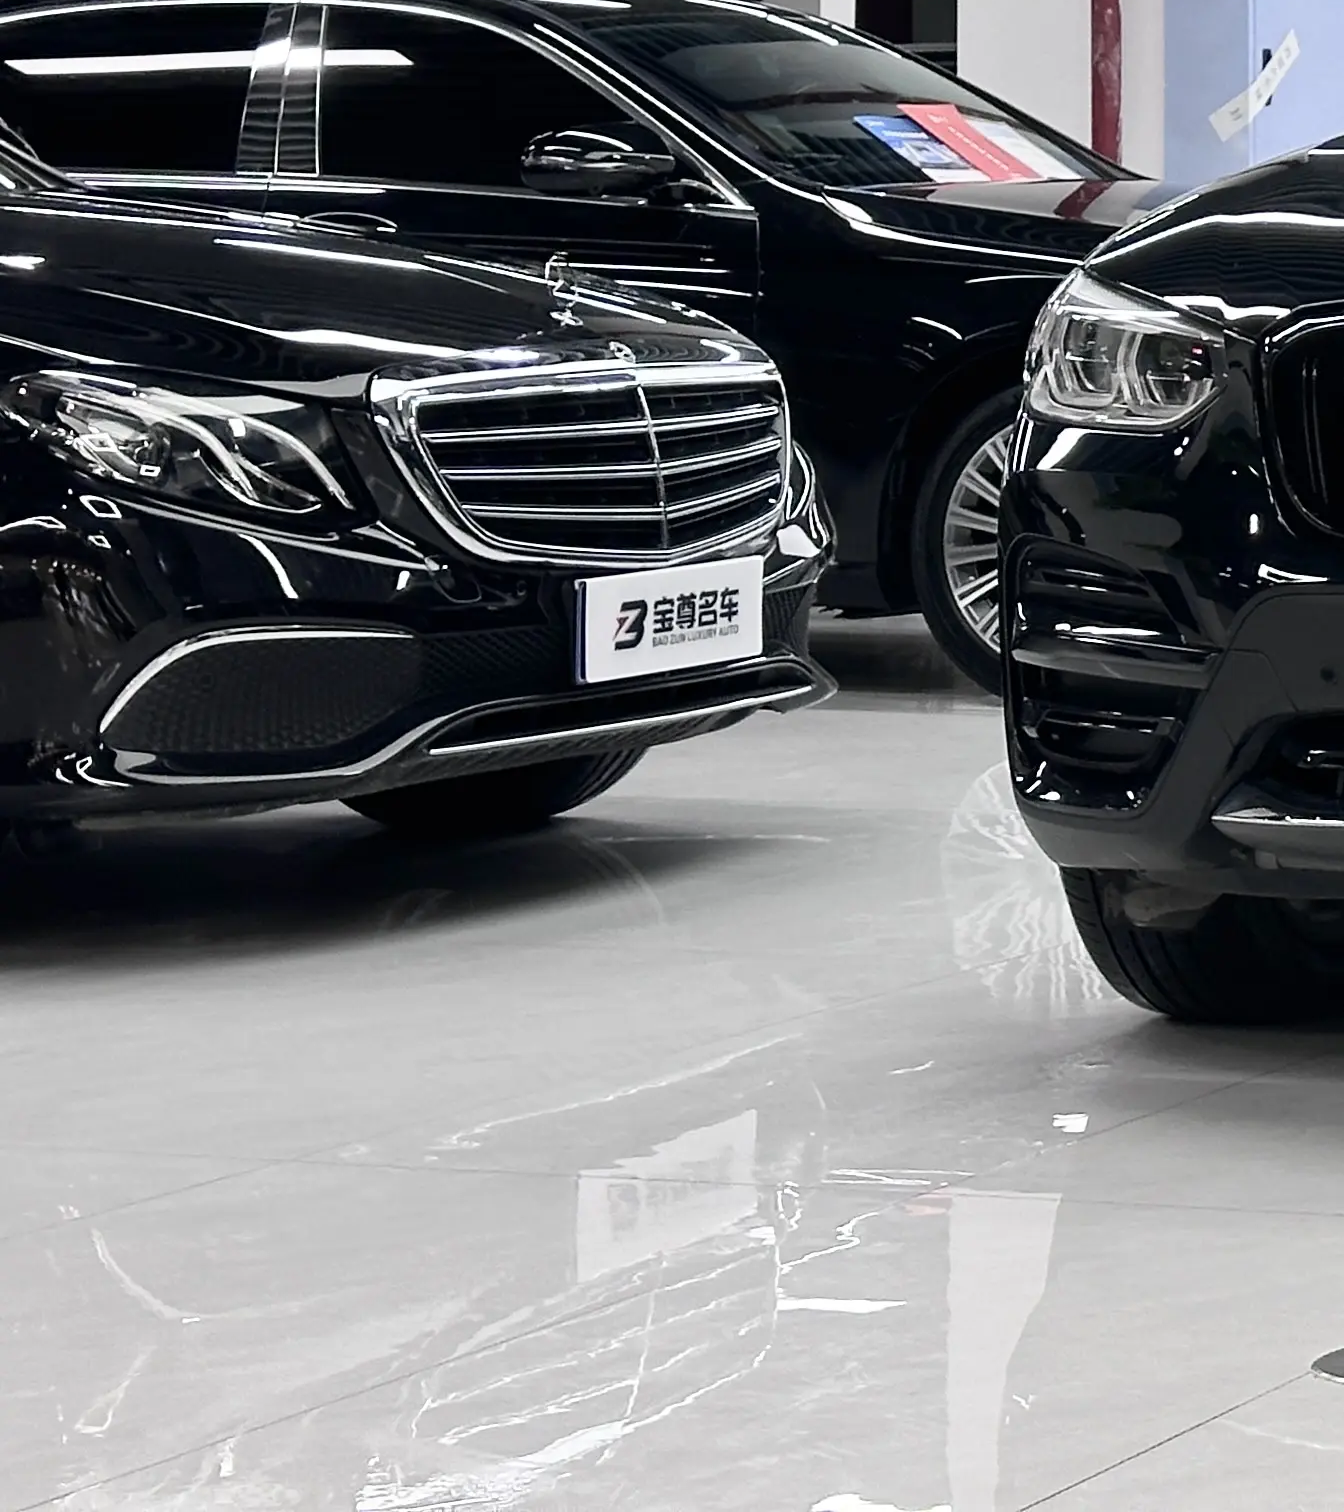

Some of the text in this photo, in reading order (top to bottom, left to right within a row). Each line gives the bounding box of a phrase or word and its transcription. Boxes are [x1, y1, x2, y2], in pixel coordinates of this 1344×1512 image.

[653, 586, 739, 634] 宝尊名车
[718, 624, 739, 636] AUTO
